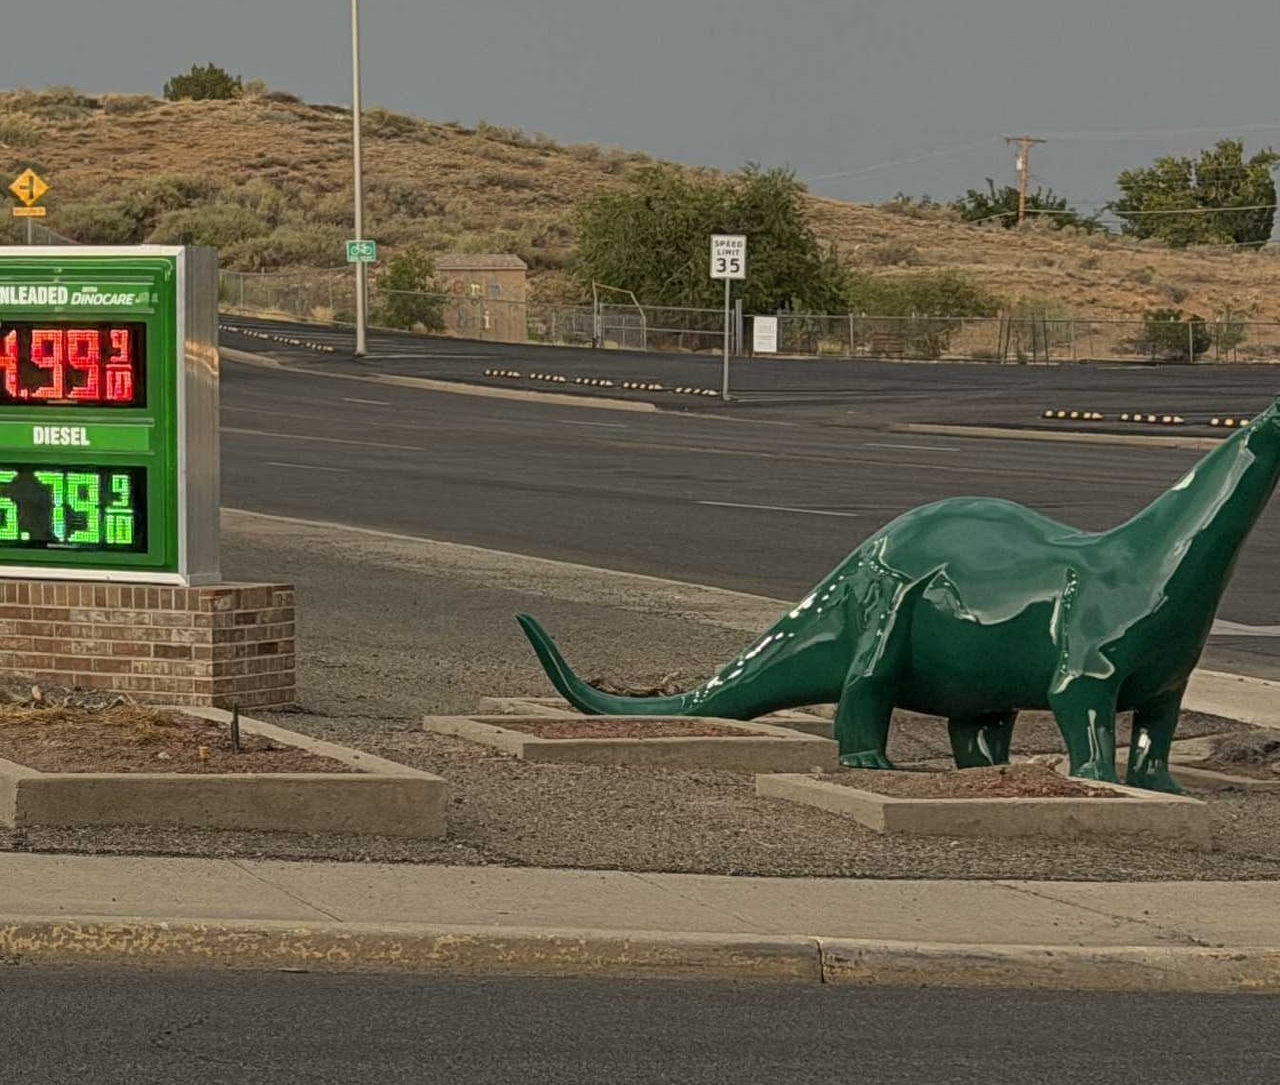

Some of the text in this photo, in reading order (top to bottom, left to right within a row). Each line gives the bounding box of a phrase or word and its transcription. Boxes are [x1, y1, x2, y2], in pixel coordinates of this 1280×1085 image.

[714, 240, 743, 248] SPEED
[716, 258, 740, 273] 35
[71, 292, 135, 305] DINOCARE
[32, 426, 90, 446] DIESEL
